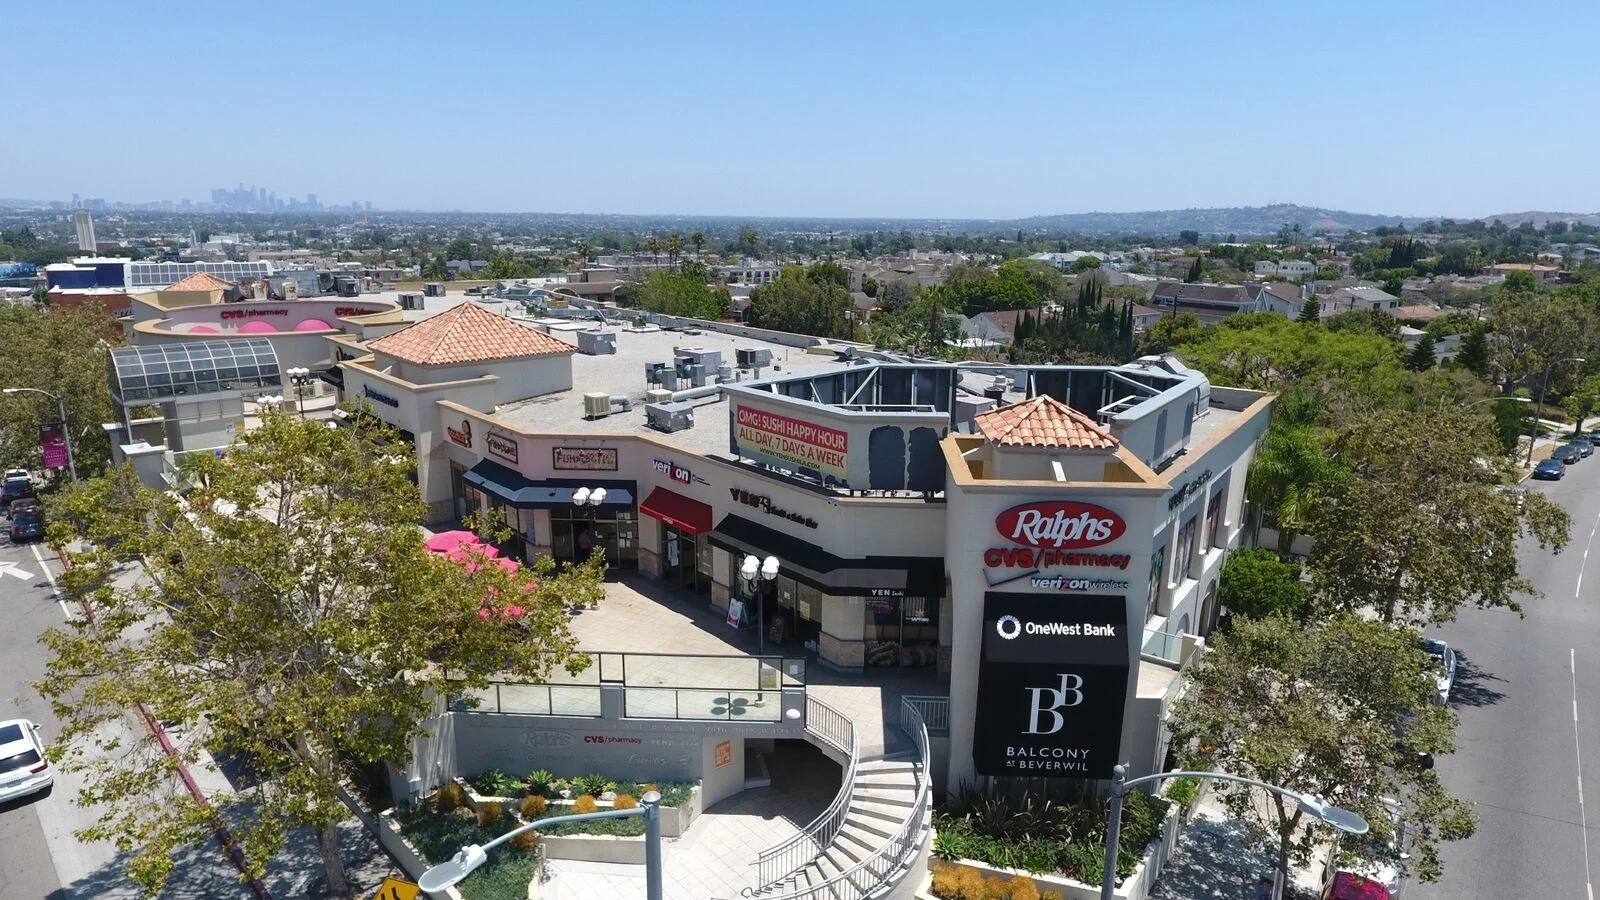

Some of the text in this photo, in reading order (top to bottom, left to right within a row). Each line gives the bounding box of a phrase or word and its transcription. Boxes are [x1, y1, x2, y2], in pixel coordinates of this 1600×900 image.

[220, 308, 289, 319] CVS/pharmacy
[739, 409, 845, 450] OMG! SUSHI HAPPY HOUR
[739, 427, 844, 468] ALL DAY, 7 DAYS A WEEK
[651, 459, 690, 484] verizon
[1011, 509, 1114, 547] Ralphs
[983, 547, 1131, 571] CVS/pharmacy
[1025, 621, 1116, 637] OneWest Bank
[584, 735, 642, 745] CVS/pharmacy
[1006, 746, 1090, 759] BALCONY
[1019, 760, 1089, 772] BEVERWIL
